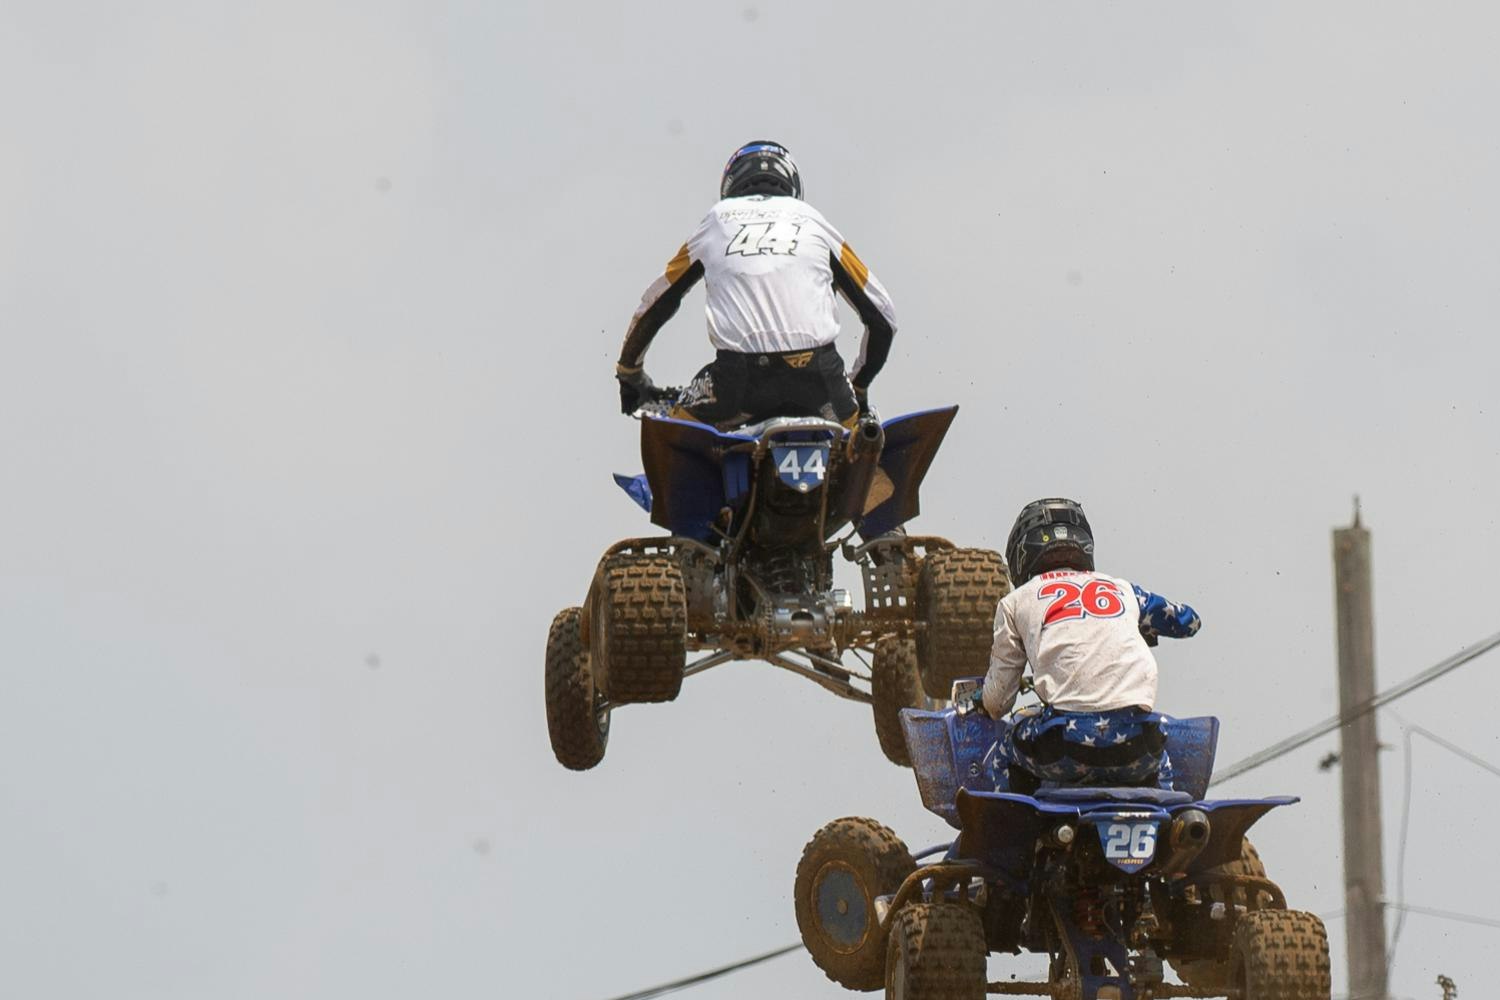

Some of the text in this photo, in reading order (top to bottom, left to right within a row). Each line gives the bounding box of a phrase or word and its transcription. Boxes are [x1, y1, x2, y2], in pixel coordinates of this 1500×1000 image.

[725, 221, 802, 257] 44
[778, 449, 826, 480] 44
[1037, 579, 1125, 627] 26
[1105, 823, 1156, 858] 26
